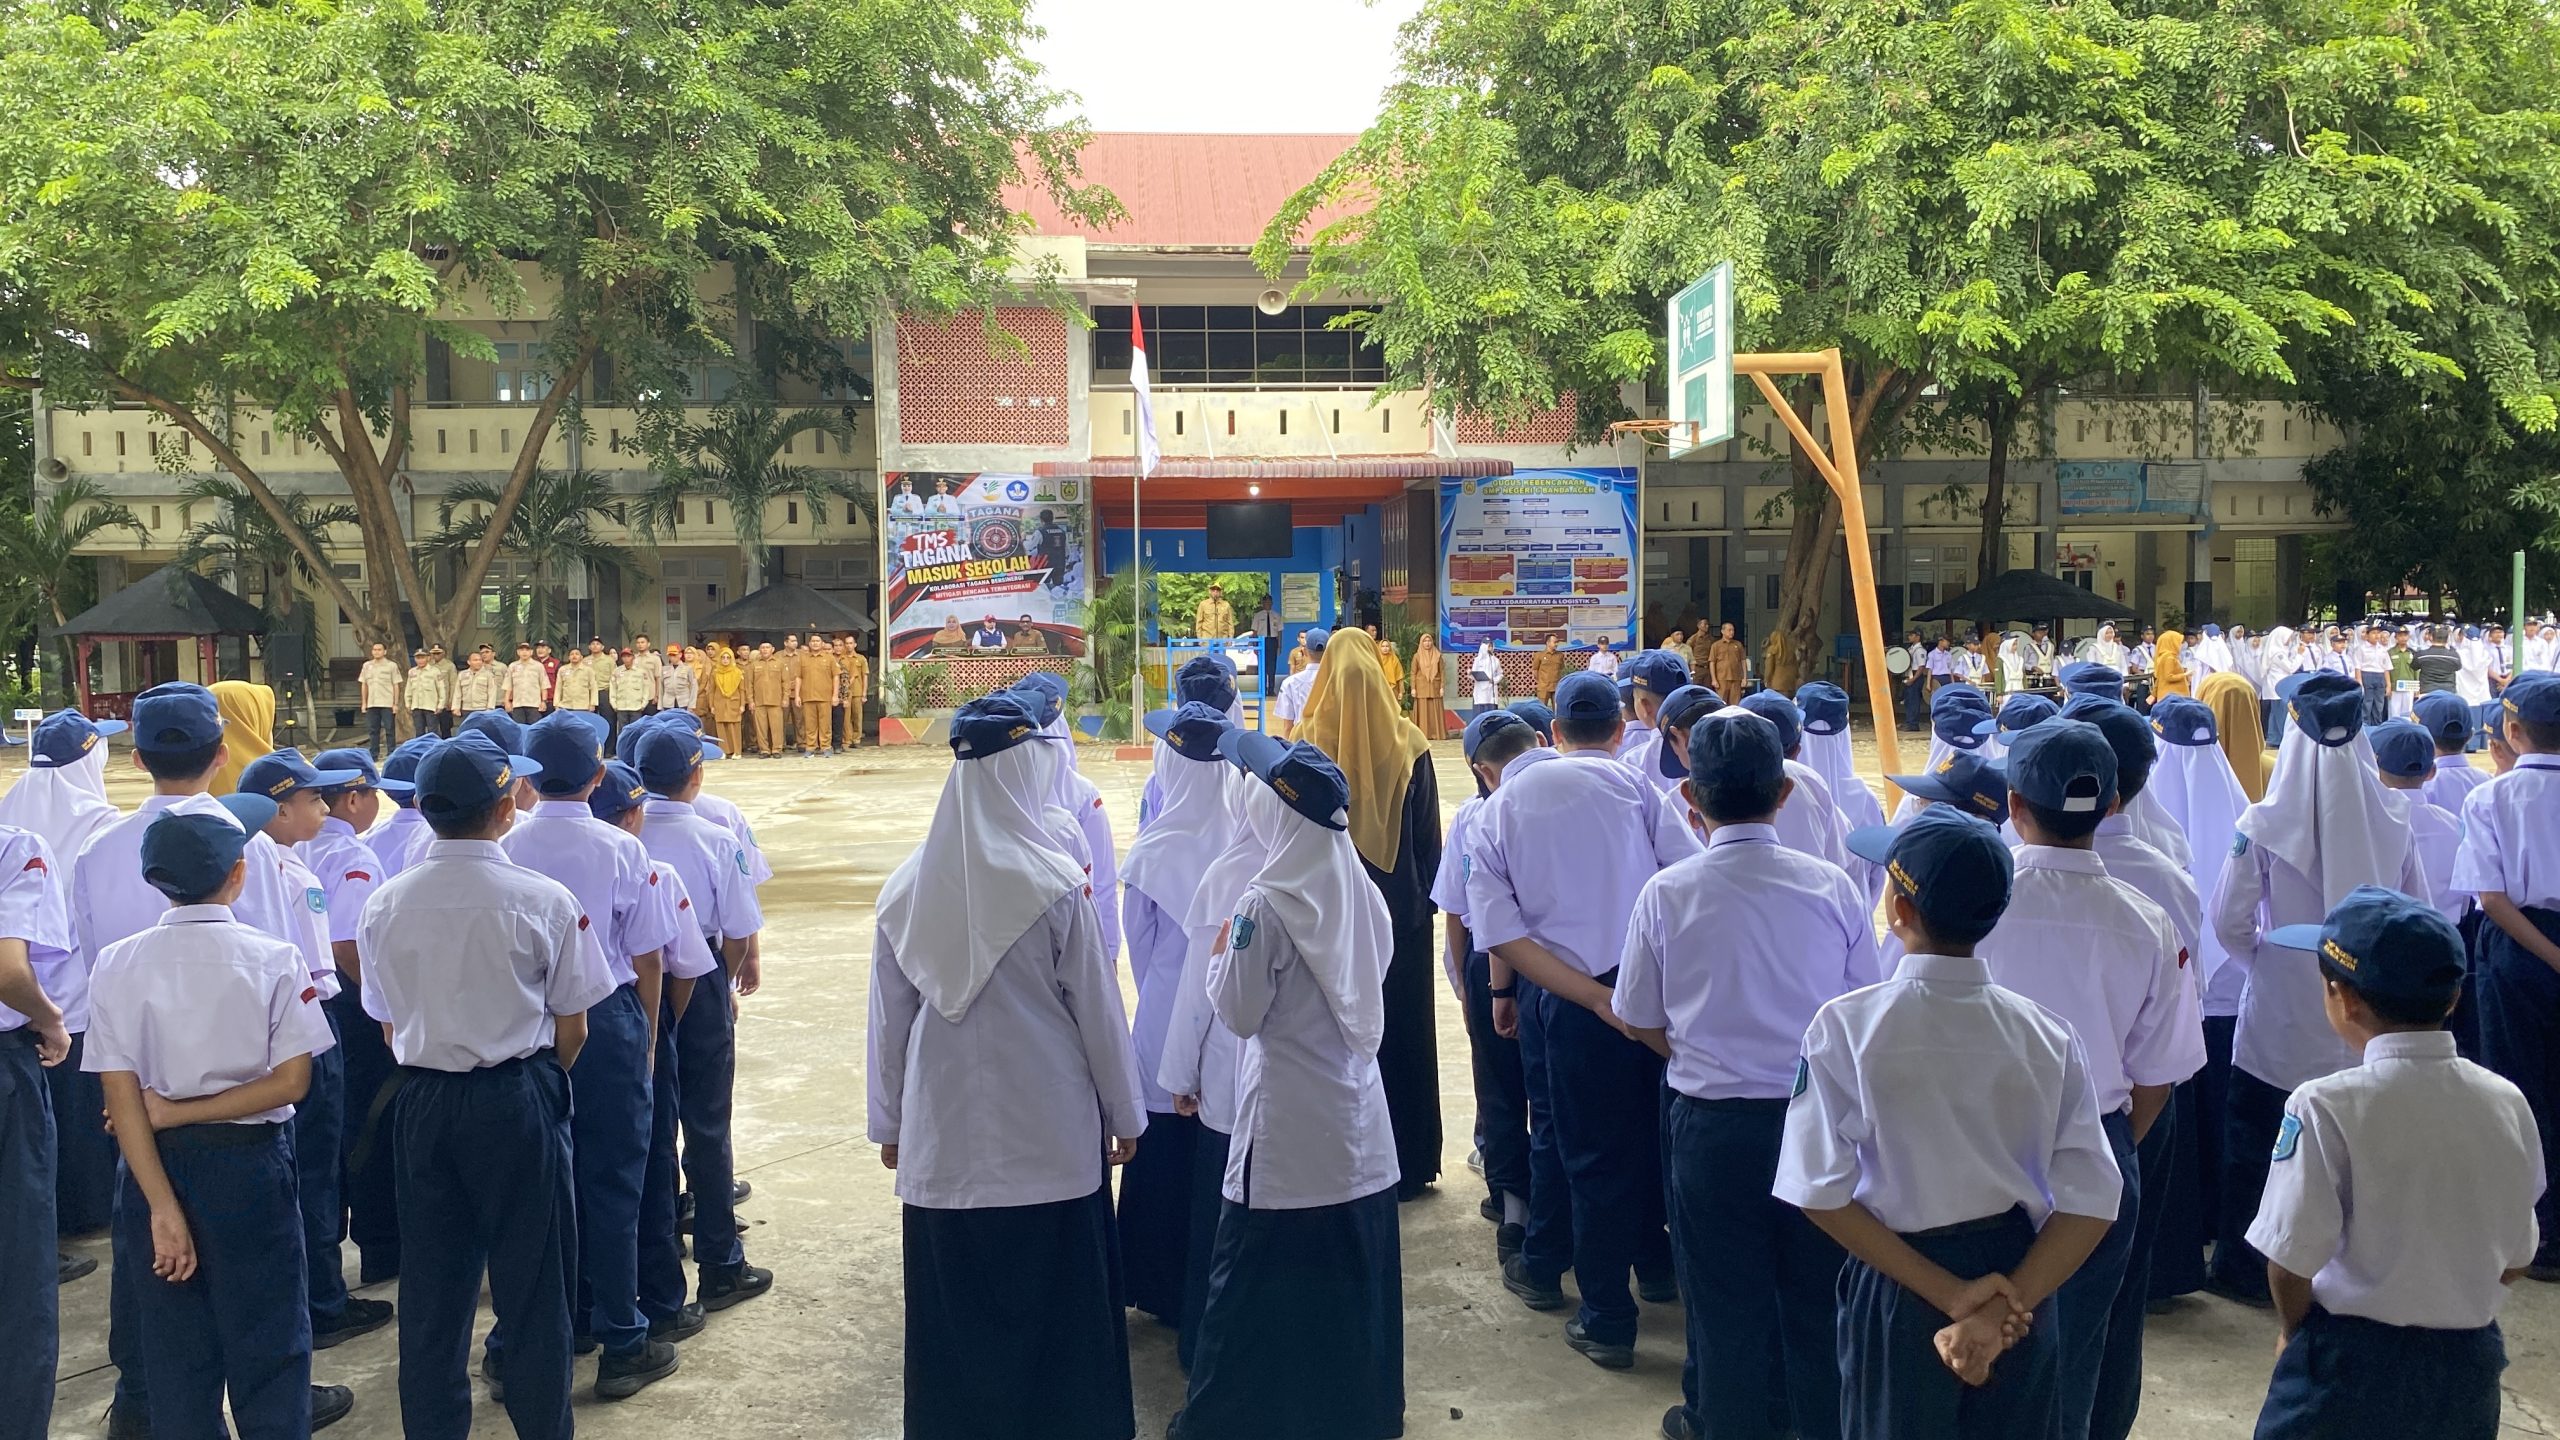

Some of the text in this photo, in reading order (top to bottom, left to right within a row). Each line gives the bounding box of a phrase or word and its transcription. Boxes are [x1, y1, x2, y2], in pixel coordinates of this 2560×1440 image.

[969, 507, 1020, 518] TAGANA
[913, 531, 948, 551] TMS
[900, 543, 973, 568] TAGANA
[906, 555, 1031, 585] MASUK SEKOLAH
[929, 583, 966, 592] KOLABORASI
[935, 590, 962, 599] MITIGASI
